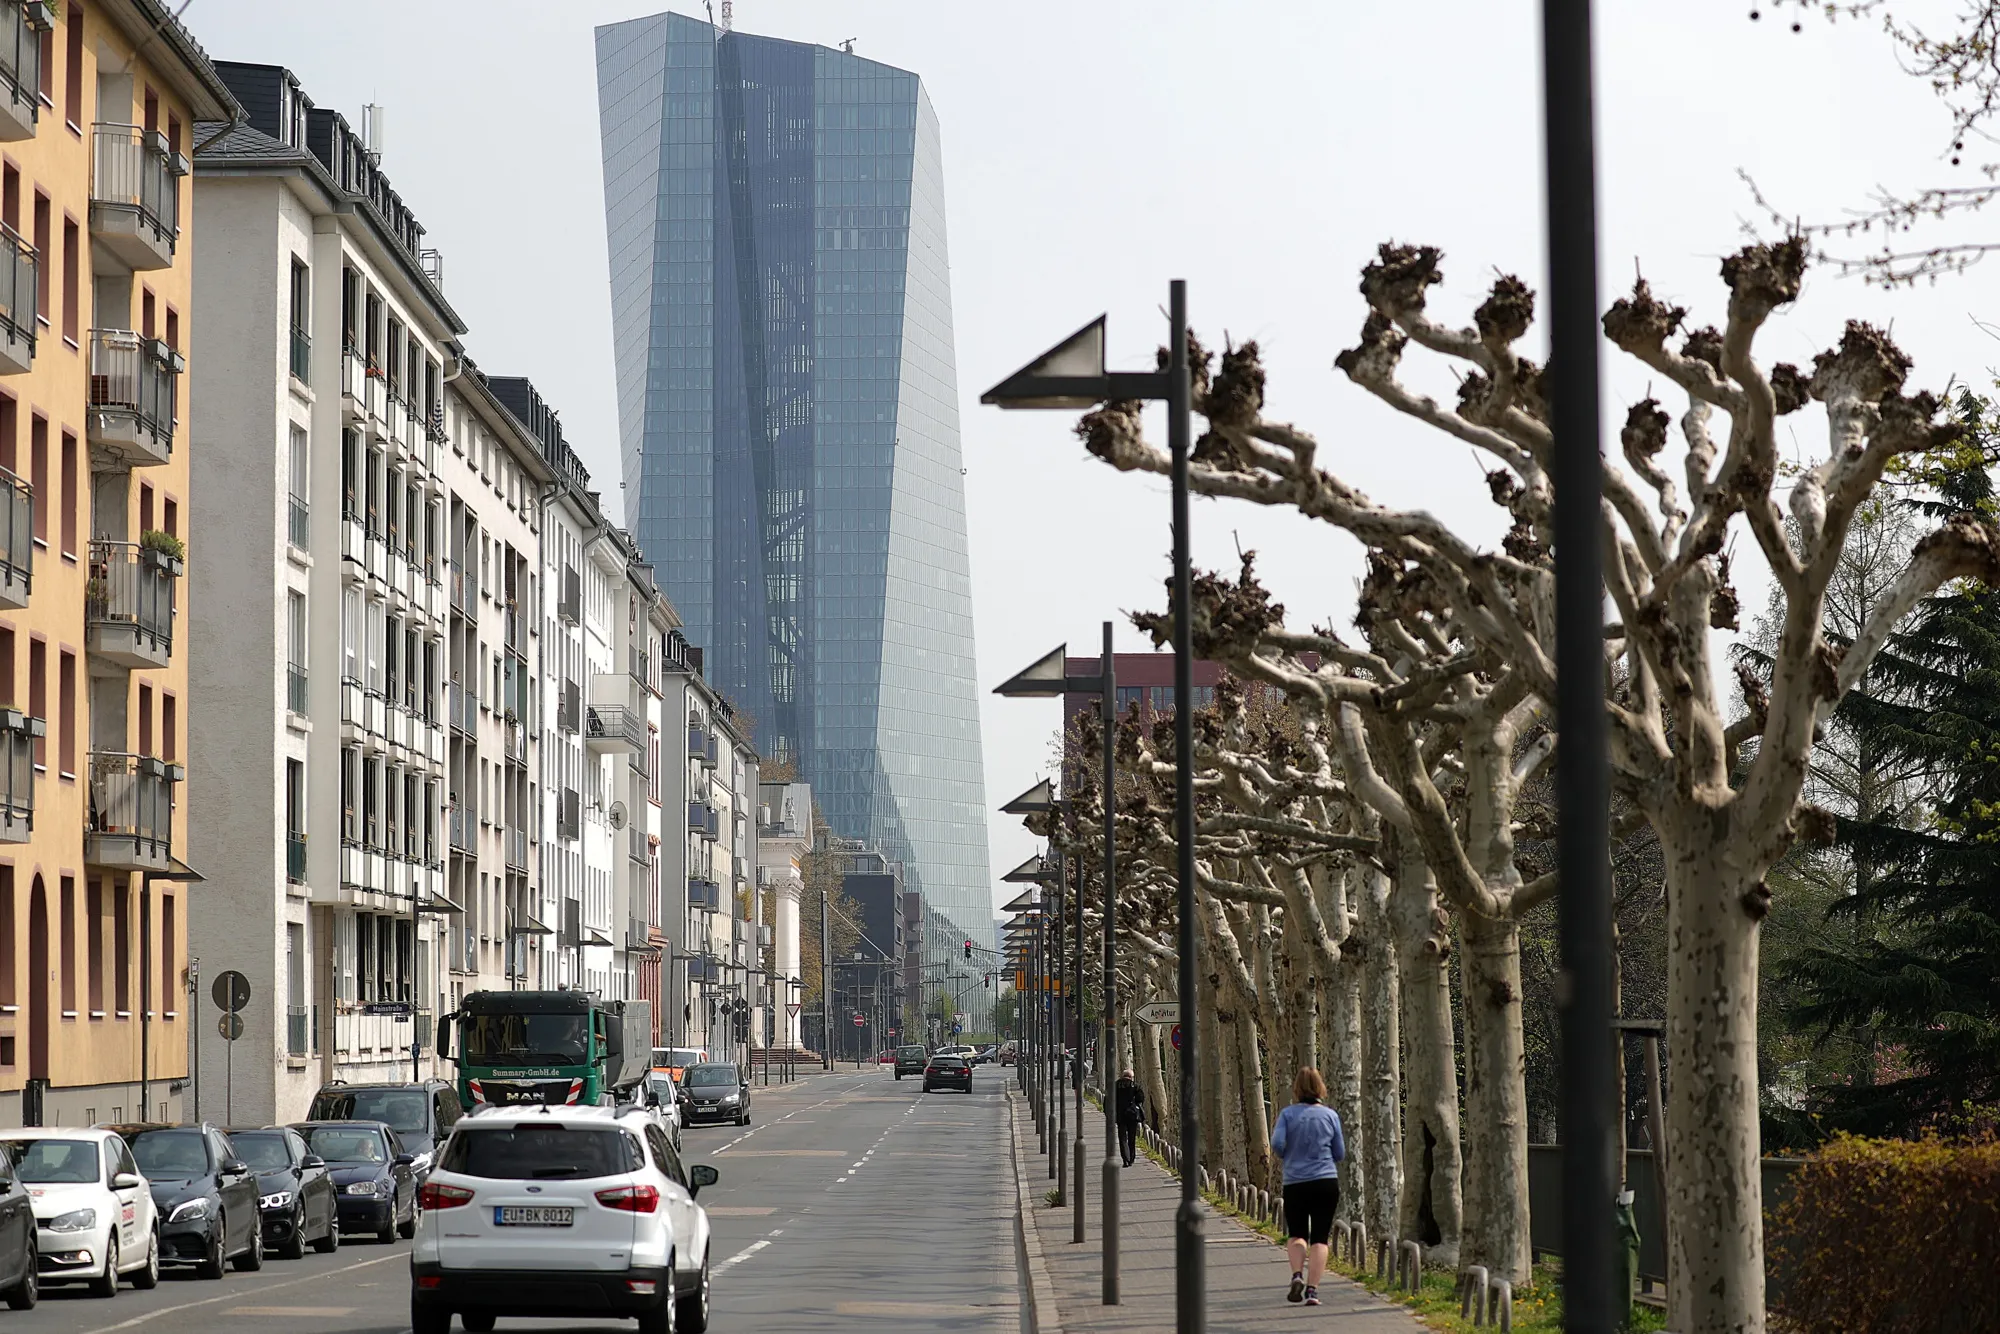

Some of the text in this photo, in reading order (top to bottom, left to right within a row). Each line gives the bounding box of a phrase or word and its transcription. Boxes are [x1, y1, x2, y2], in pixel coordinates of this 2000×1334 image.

[1151, 1009, 1176, 1019] Agntur
[493, 1069, 560, 1078] Summary-GmbH.de
[506, 1092, 545, 1101] MAN
[502, 1209, 571, 1221] EU BK 8012
